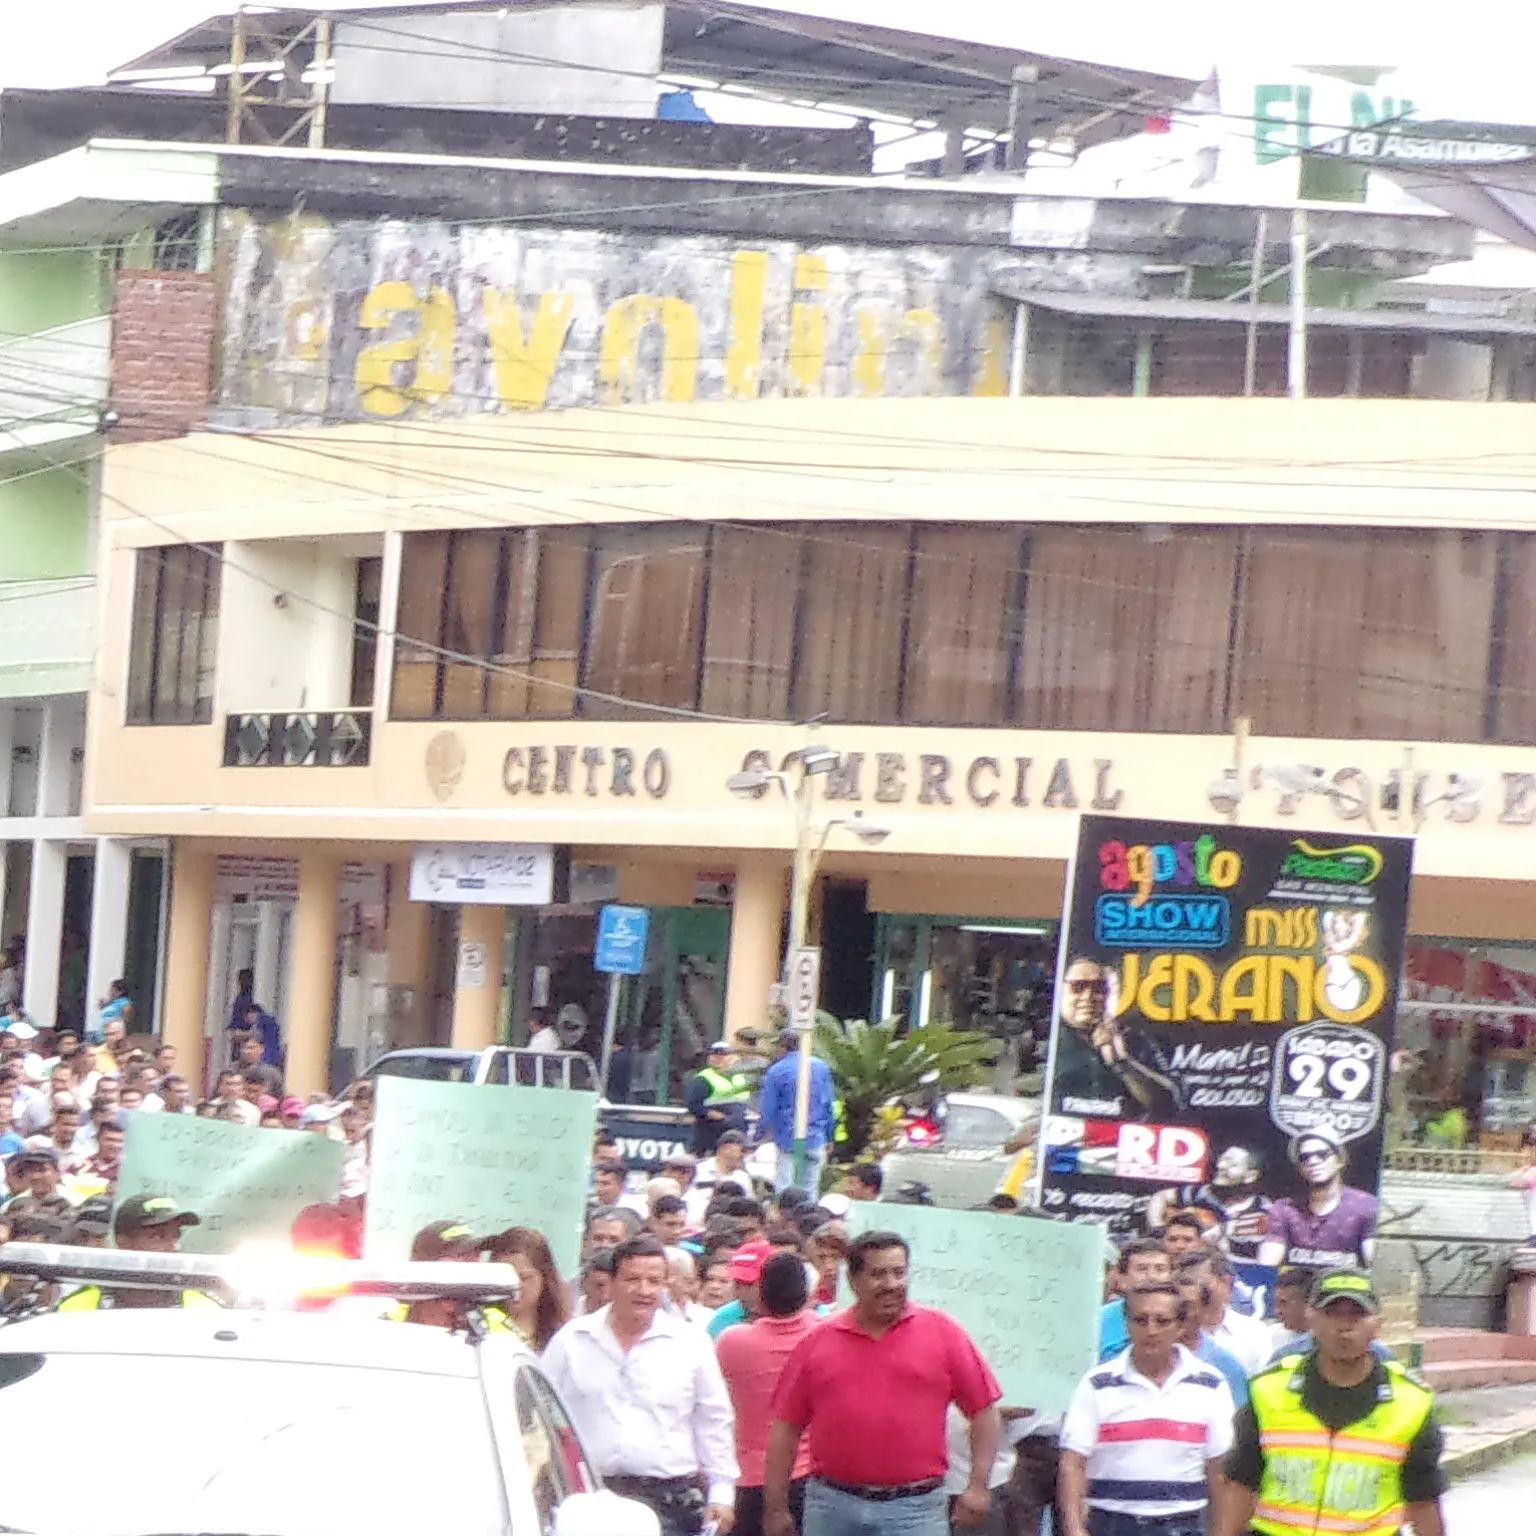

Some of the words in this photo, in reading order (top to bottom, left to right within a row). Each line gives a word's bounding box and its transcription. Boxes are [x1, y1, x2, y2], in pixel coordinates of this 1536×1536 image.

[502, 745, 672, 799] CENTRO
[1098, 834, 1242, 909] agosto
[1101, 901, 1222, 930] SHOW
[1288, 1054, 1371, 1101] 29
[615, 1137, 687, 1161] OYOTA
[1120, 1124, 1207, 1168] RD
